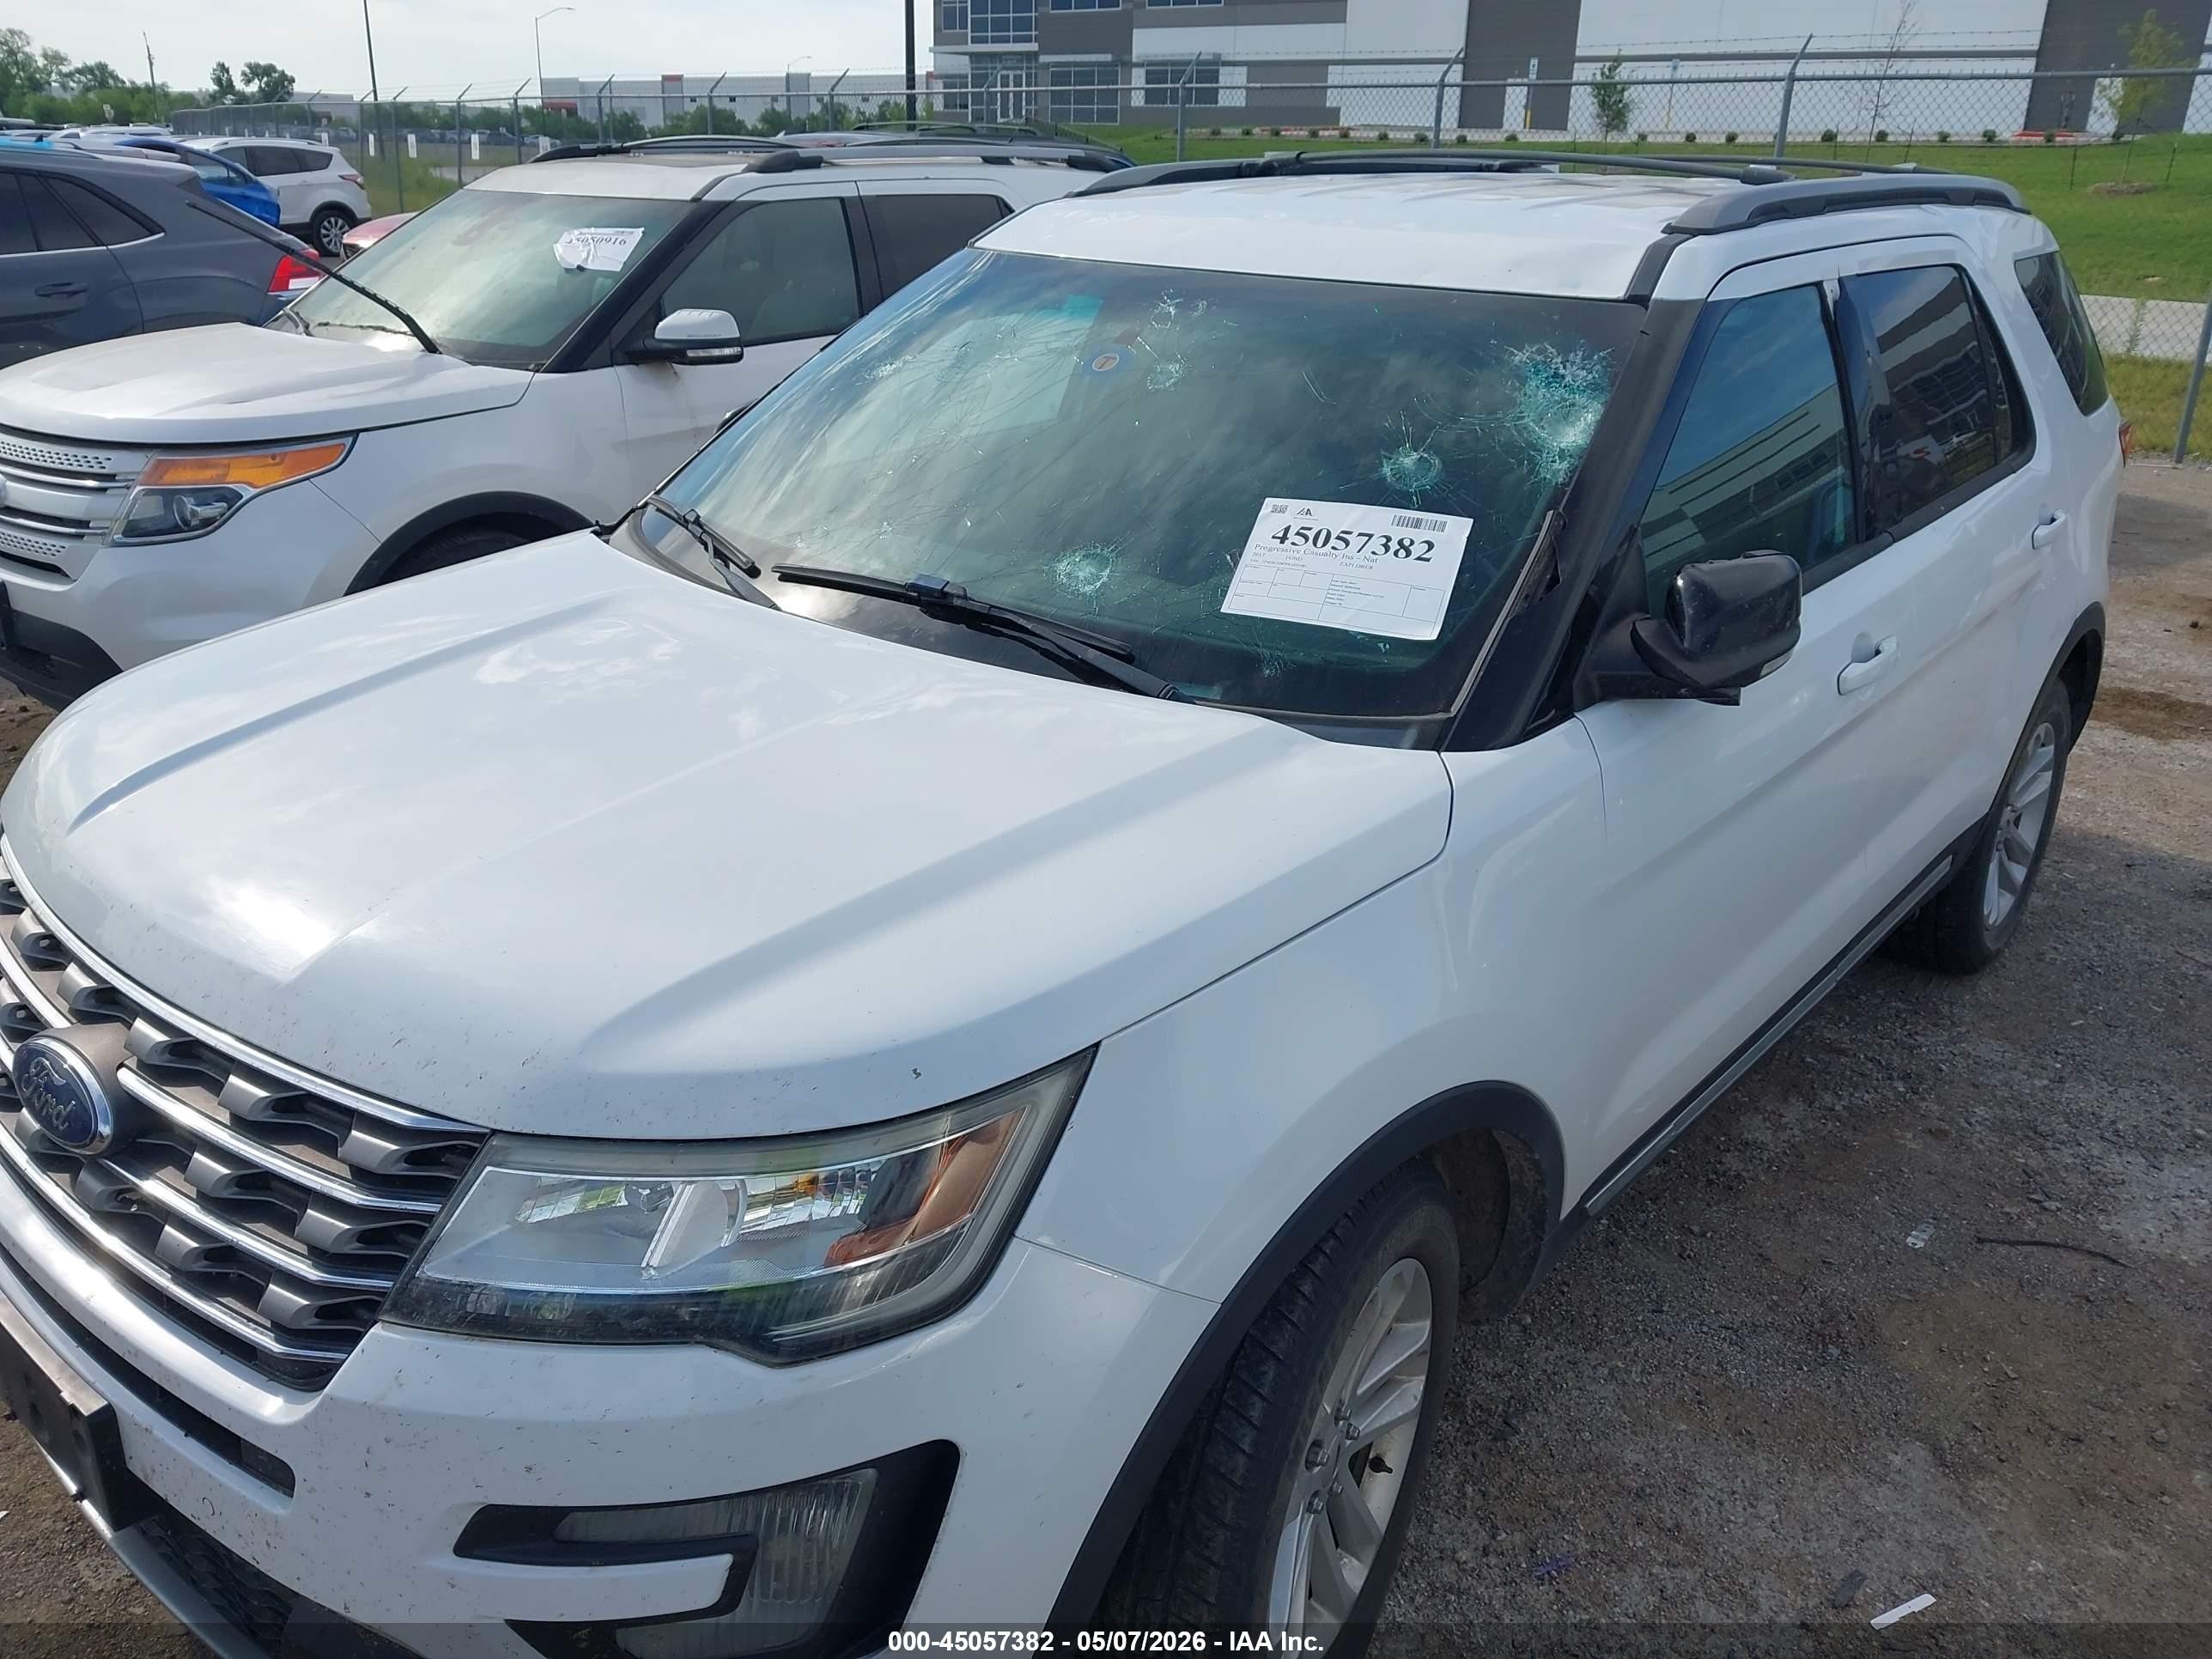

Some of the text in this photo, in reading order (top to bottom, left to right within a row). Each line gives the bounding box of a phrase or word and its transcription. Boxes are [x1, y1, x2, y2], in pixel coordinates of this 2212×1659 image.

[1254, 544, 1302, 555] Progressive
[1304, 549, 1340, 559] Casualty
[1341, 552, 1354, 561] Ins
[1271, 524, 1436, 562] 45057382
[21, 1057, 76, 1131] Ford
